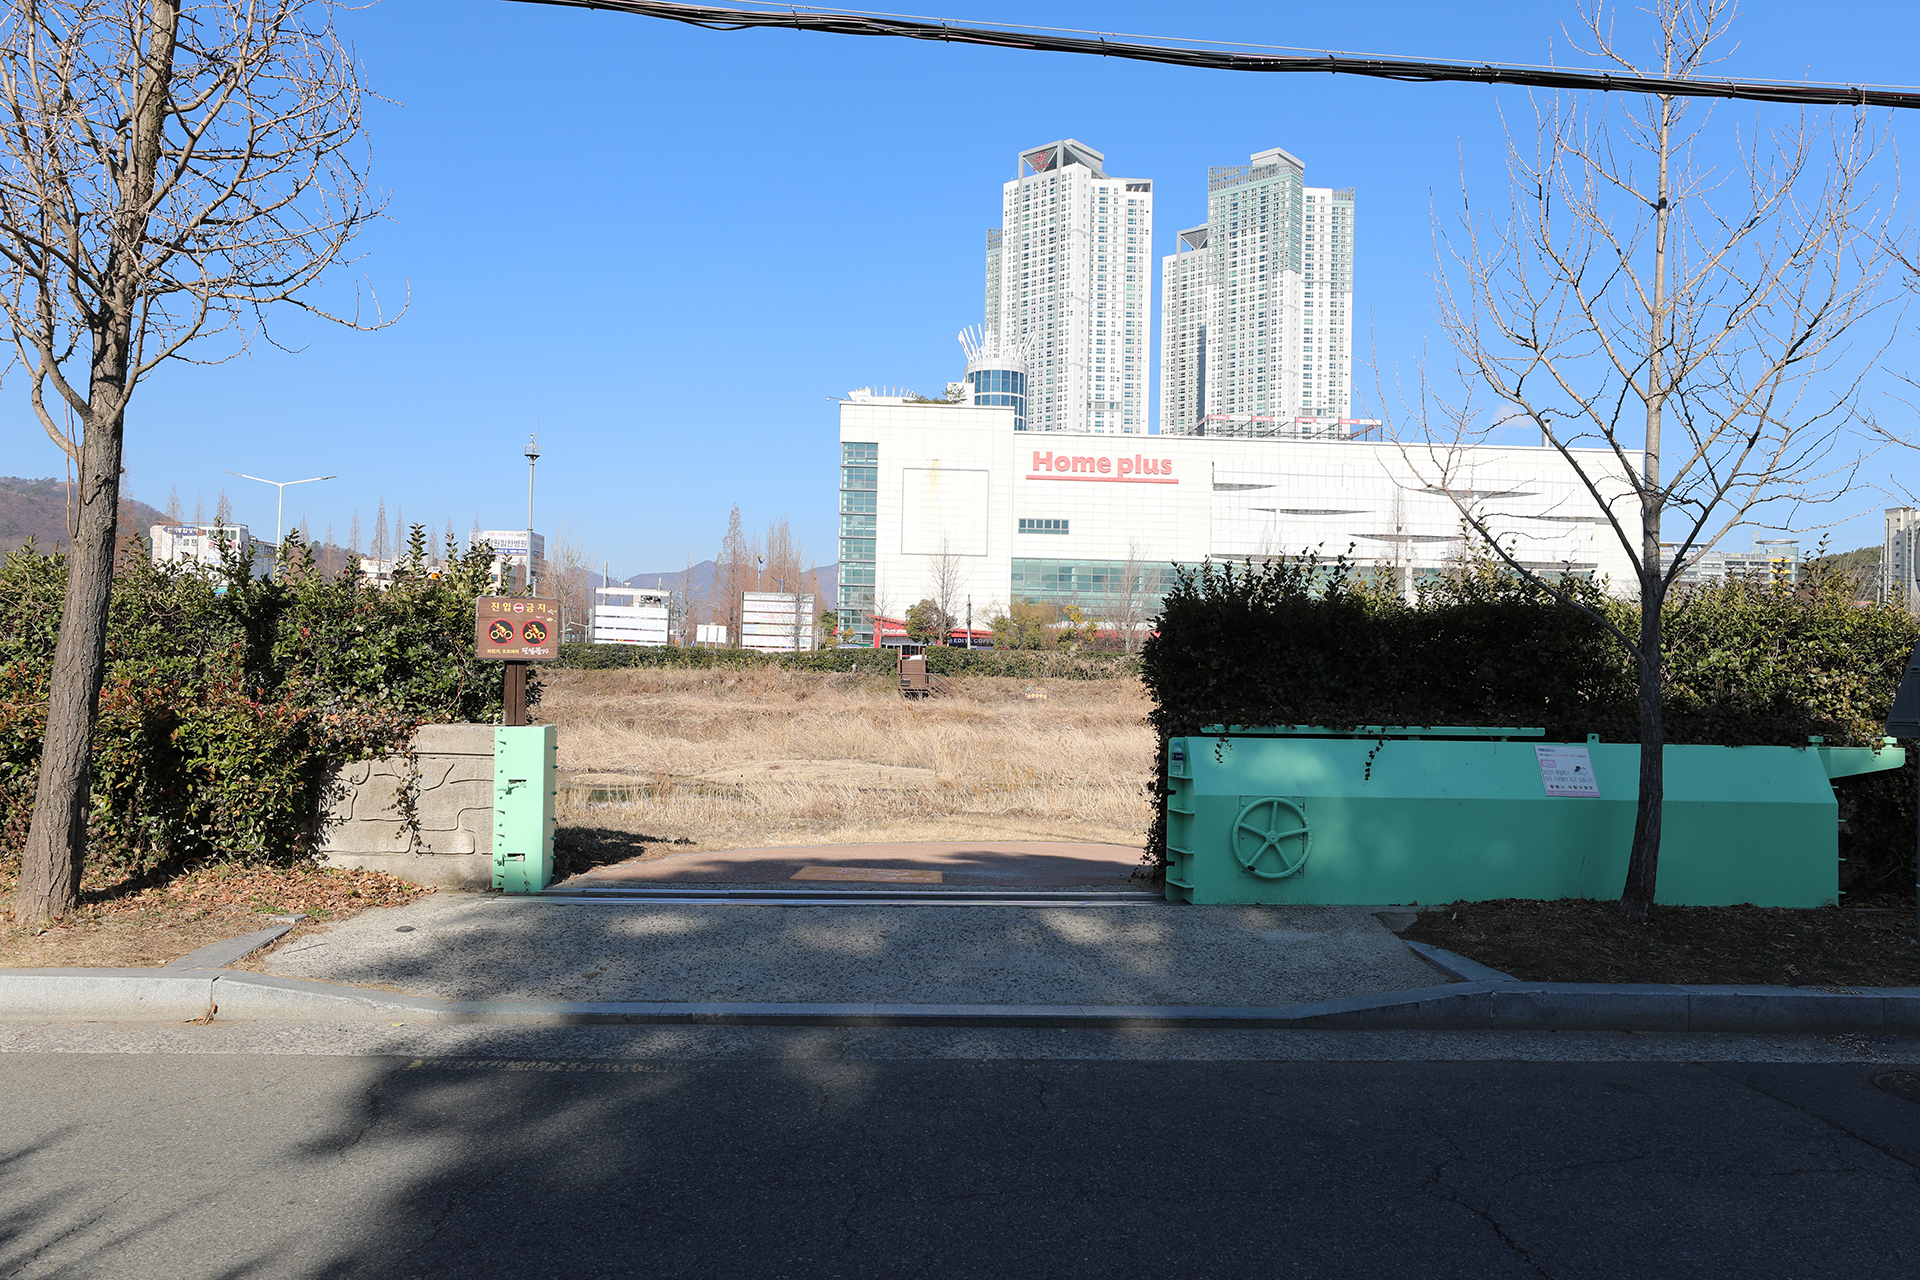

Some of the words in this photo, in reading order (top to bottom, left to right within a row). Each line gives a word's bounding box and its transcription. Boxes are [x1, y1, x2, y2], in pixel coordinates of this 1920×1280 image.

[1033, 451, 1111, 473] Home
[1117, 454, 1172, 479] plus
[490, 602, 511, 612] 진입
[526, 603, 546, 613] 금지
